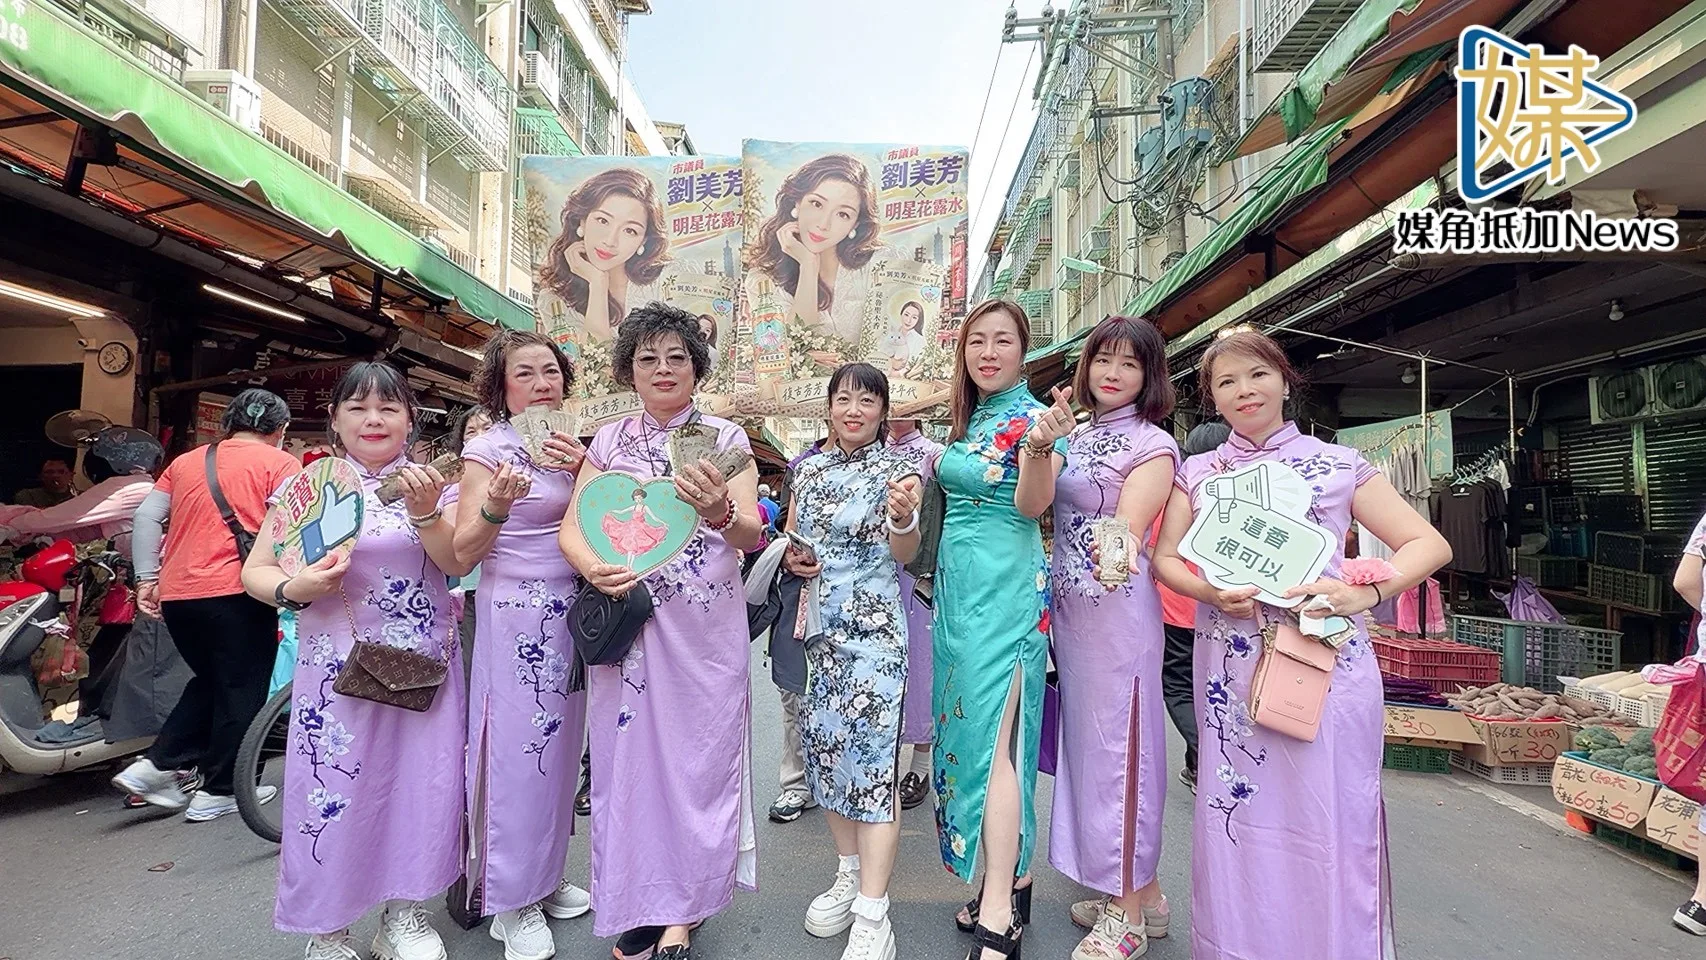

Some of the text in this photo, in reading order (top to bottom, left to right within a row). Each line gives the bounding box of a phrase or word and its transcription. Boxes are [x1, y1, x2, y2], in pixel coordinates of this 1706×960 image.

[672, 159, 704, 174] 市議員
[887, 147, 919, 160] 市議員
[667, 169, 743, 206] 劉美芳
[881, 155, 964, 191] 劉美芳
[885, 197, 963, 221] 明星花露水
[287, 472, 315, 523] 讚
[1240, 515, 1289, 550] 這香
[1215, 536, 1284, 582] 很可以
